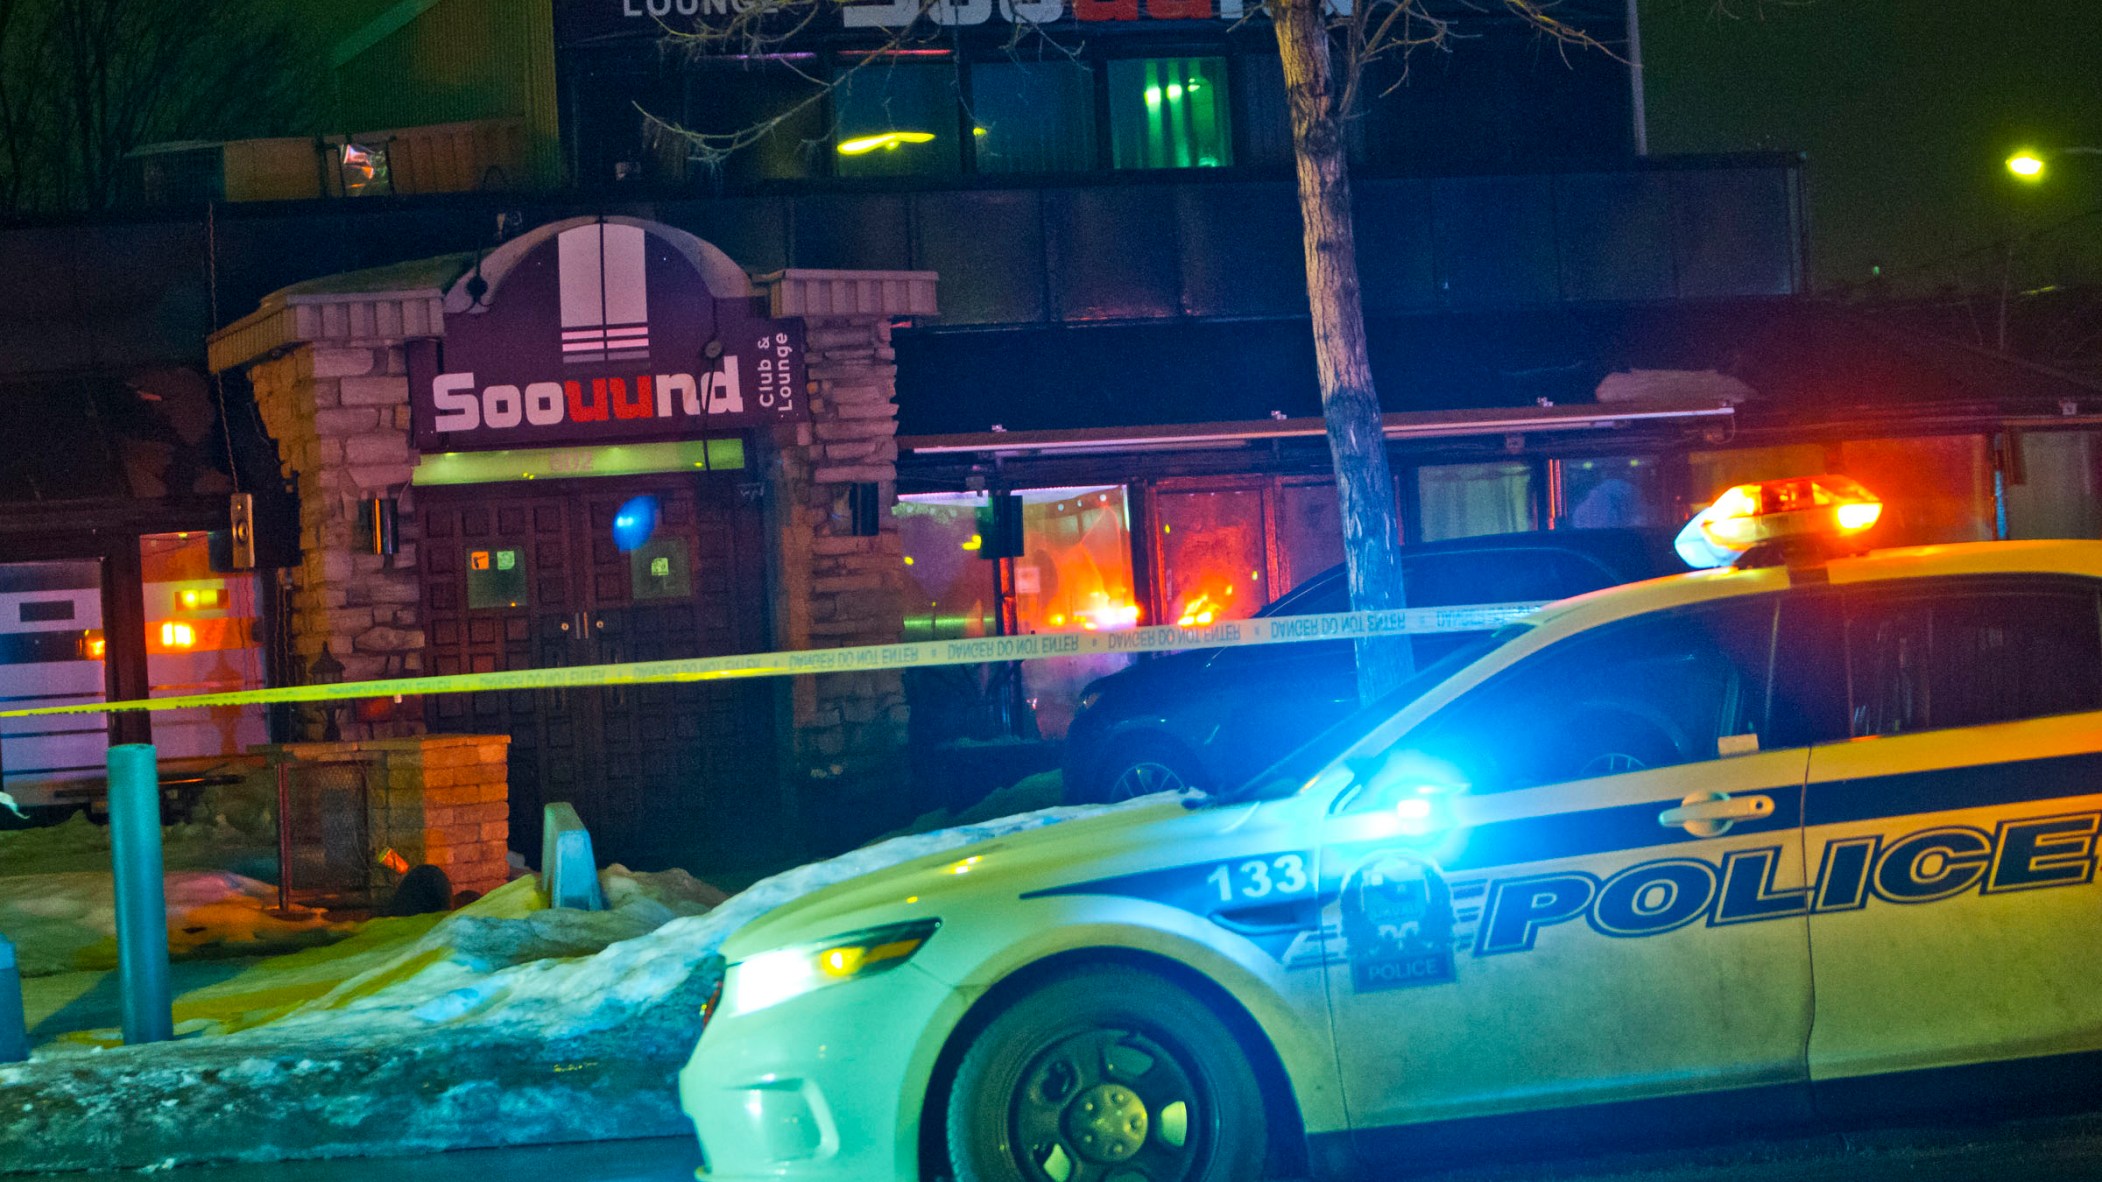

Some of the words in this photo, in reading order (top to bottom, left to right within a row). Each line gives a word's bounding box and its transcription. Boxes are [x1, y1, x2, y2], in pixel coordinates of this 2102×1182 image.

[623, 0, 779, 17] LOUN
[757, 335, 770, 350] &
[432, 355, 744, 432] Soouund
[757, 359, 774, 408] Club
[775, 332, 793, 411] Lounge
[1207, 855, 1307, 901] 133
[1472, 809, 2102, 957] POLICE
[1369, 958, 1438, 980] POLICE
